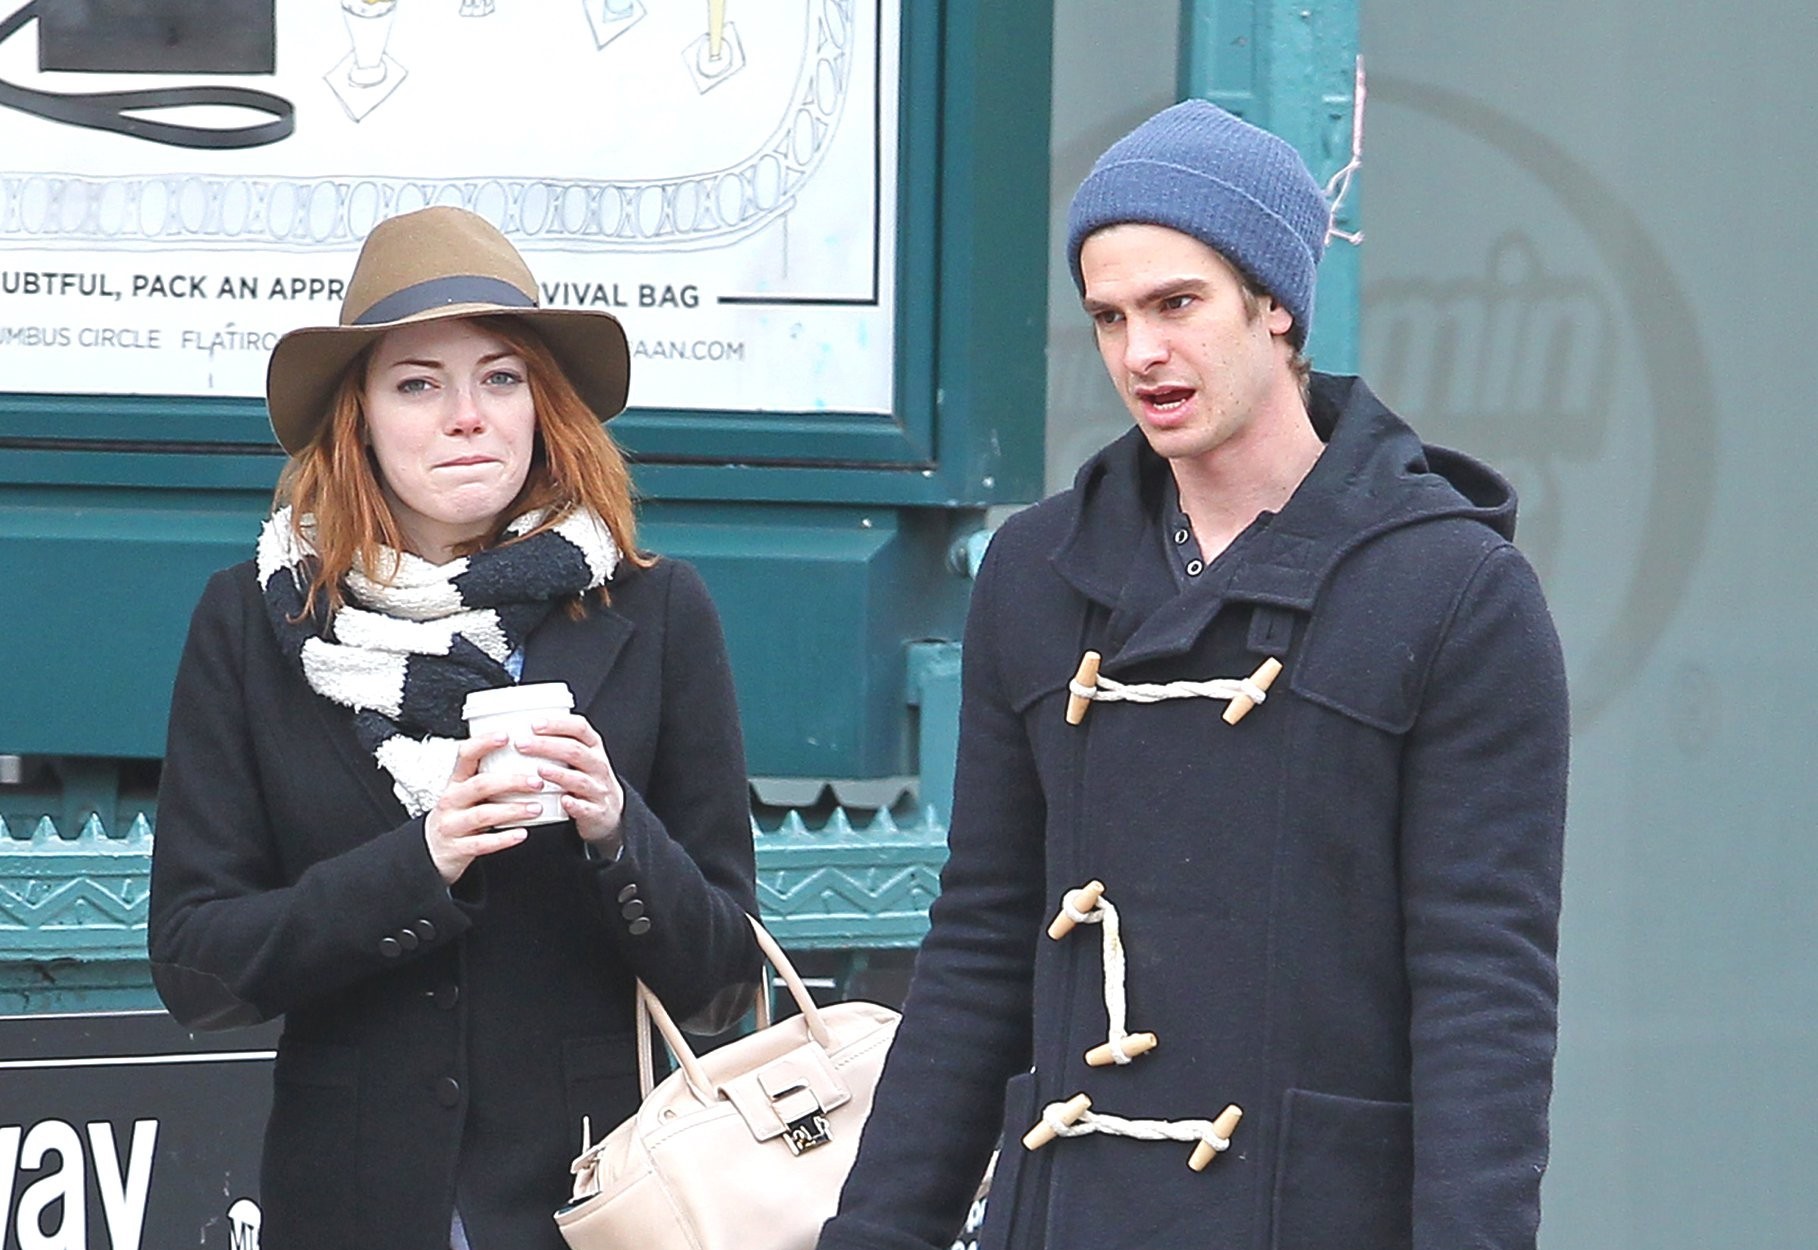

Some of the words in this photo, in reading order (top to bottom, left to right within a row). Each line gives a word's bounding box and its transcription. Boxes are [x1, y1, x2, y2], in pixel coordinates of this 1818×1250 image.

[2, 271, 122, 301] UBTFUL,
[132, 274, 208, 299] PACK
[216, 276, 258, 300] AN
[268, 277, 345, 301] APPR
[541, 281, 628, 308] VIVAL
[638, 284, 700, 308] BAG
[78, 327, 161, 349] CIRCLE
